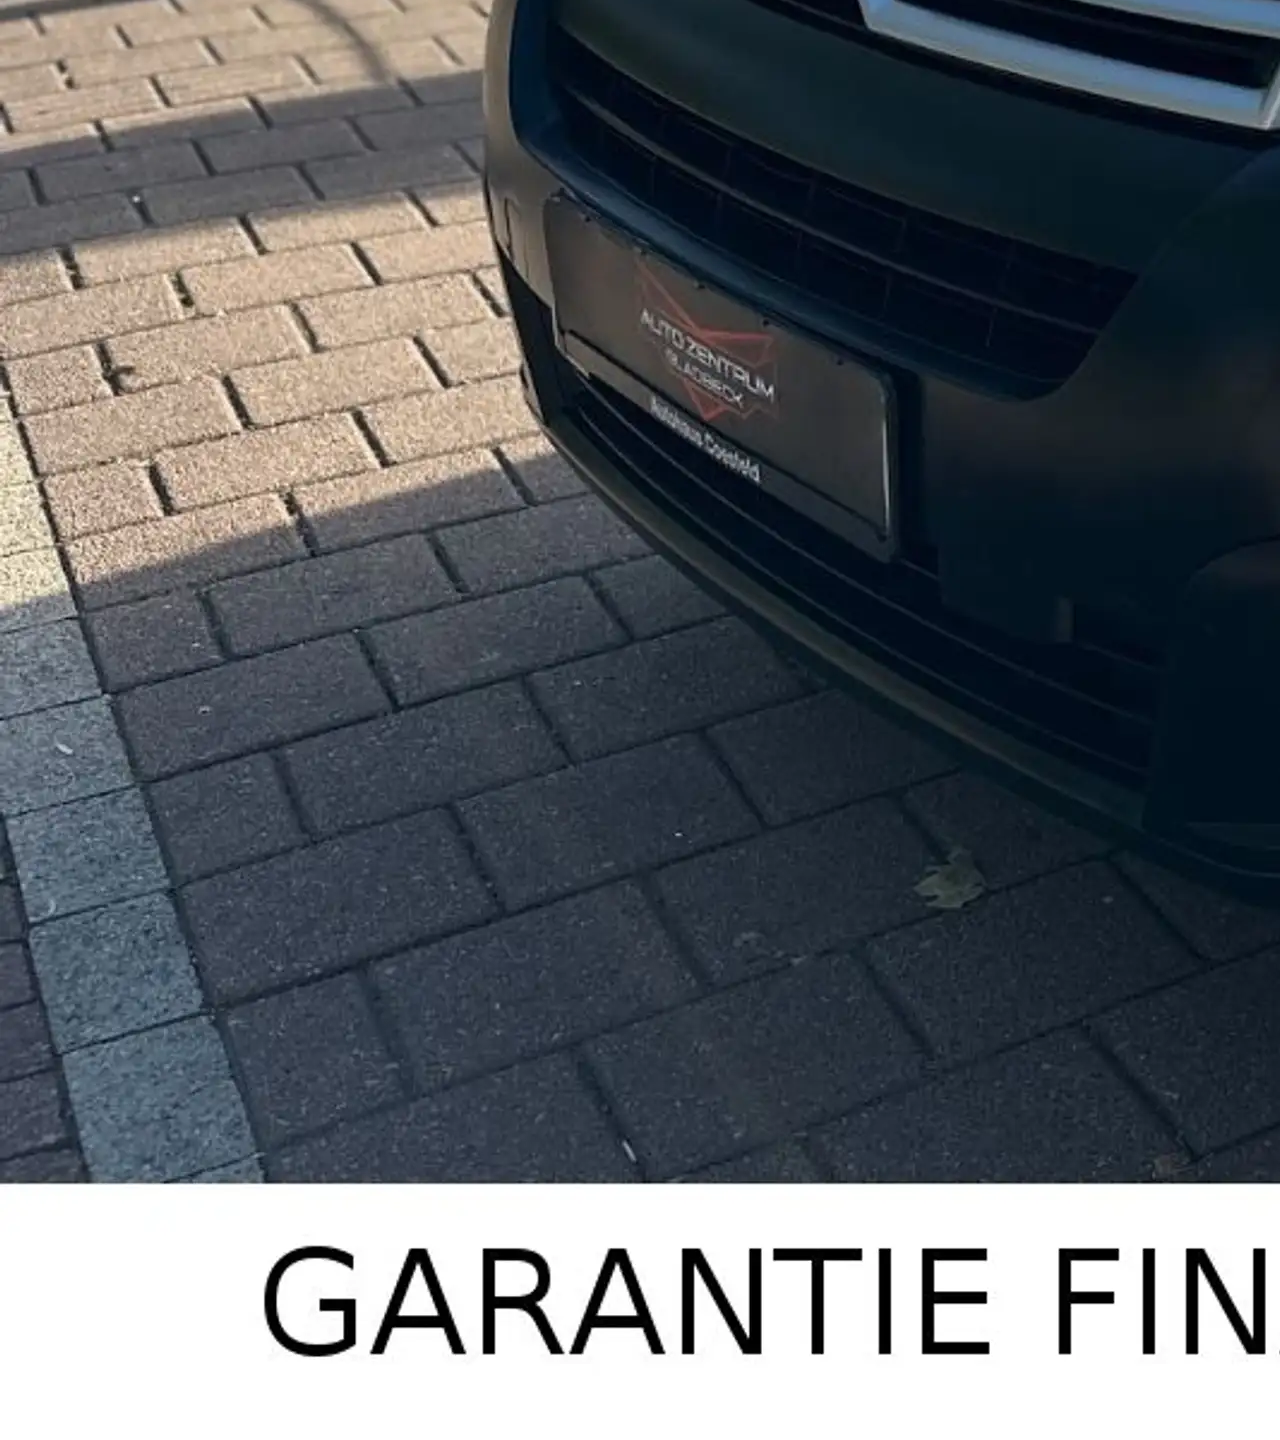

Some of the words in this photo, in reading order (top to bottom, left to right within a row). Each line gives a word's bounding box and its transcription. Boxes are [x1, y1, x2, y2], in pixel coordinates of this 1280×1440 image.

[664, 346, 744, 410] GLADBECK
[686, 334, 775, 405] ZENTRUM
[650, 393, 703, 448] Autohaus
